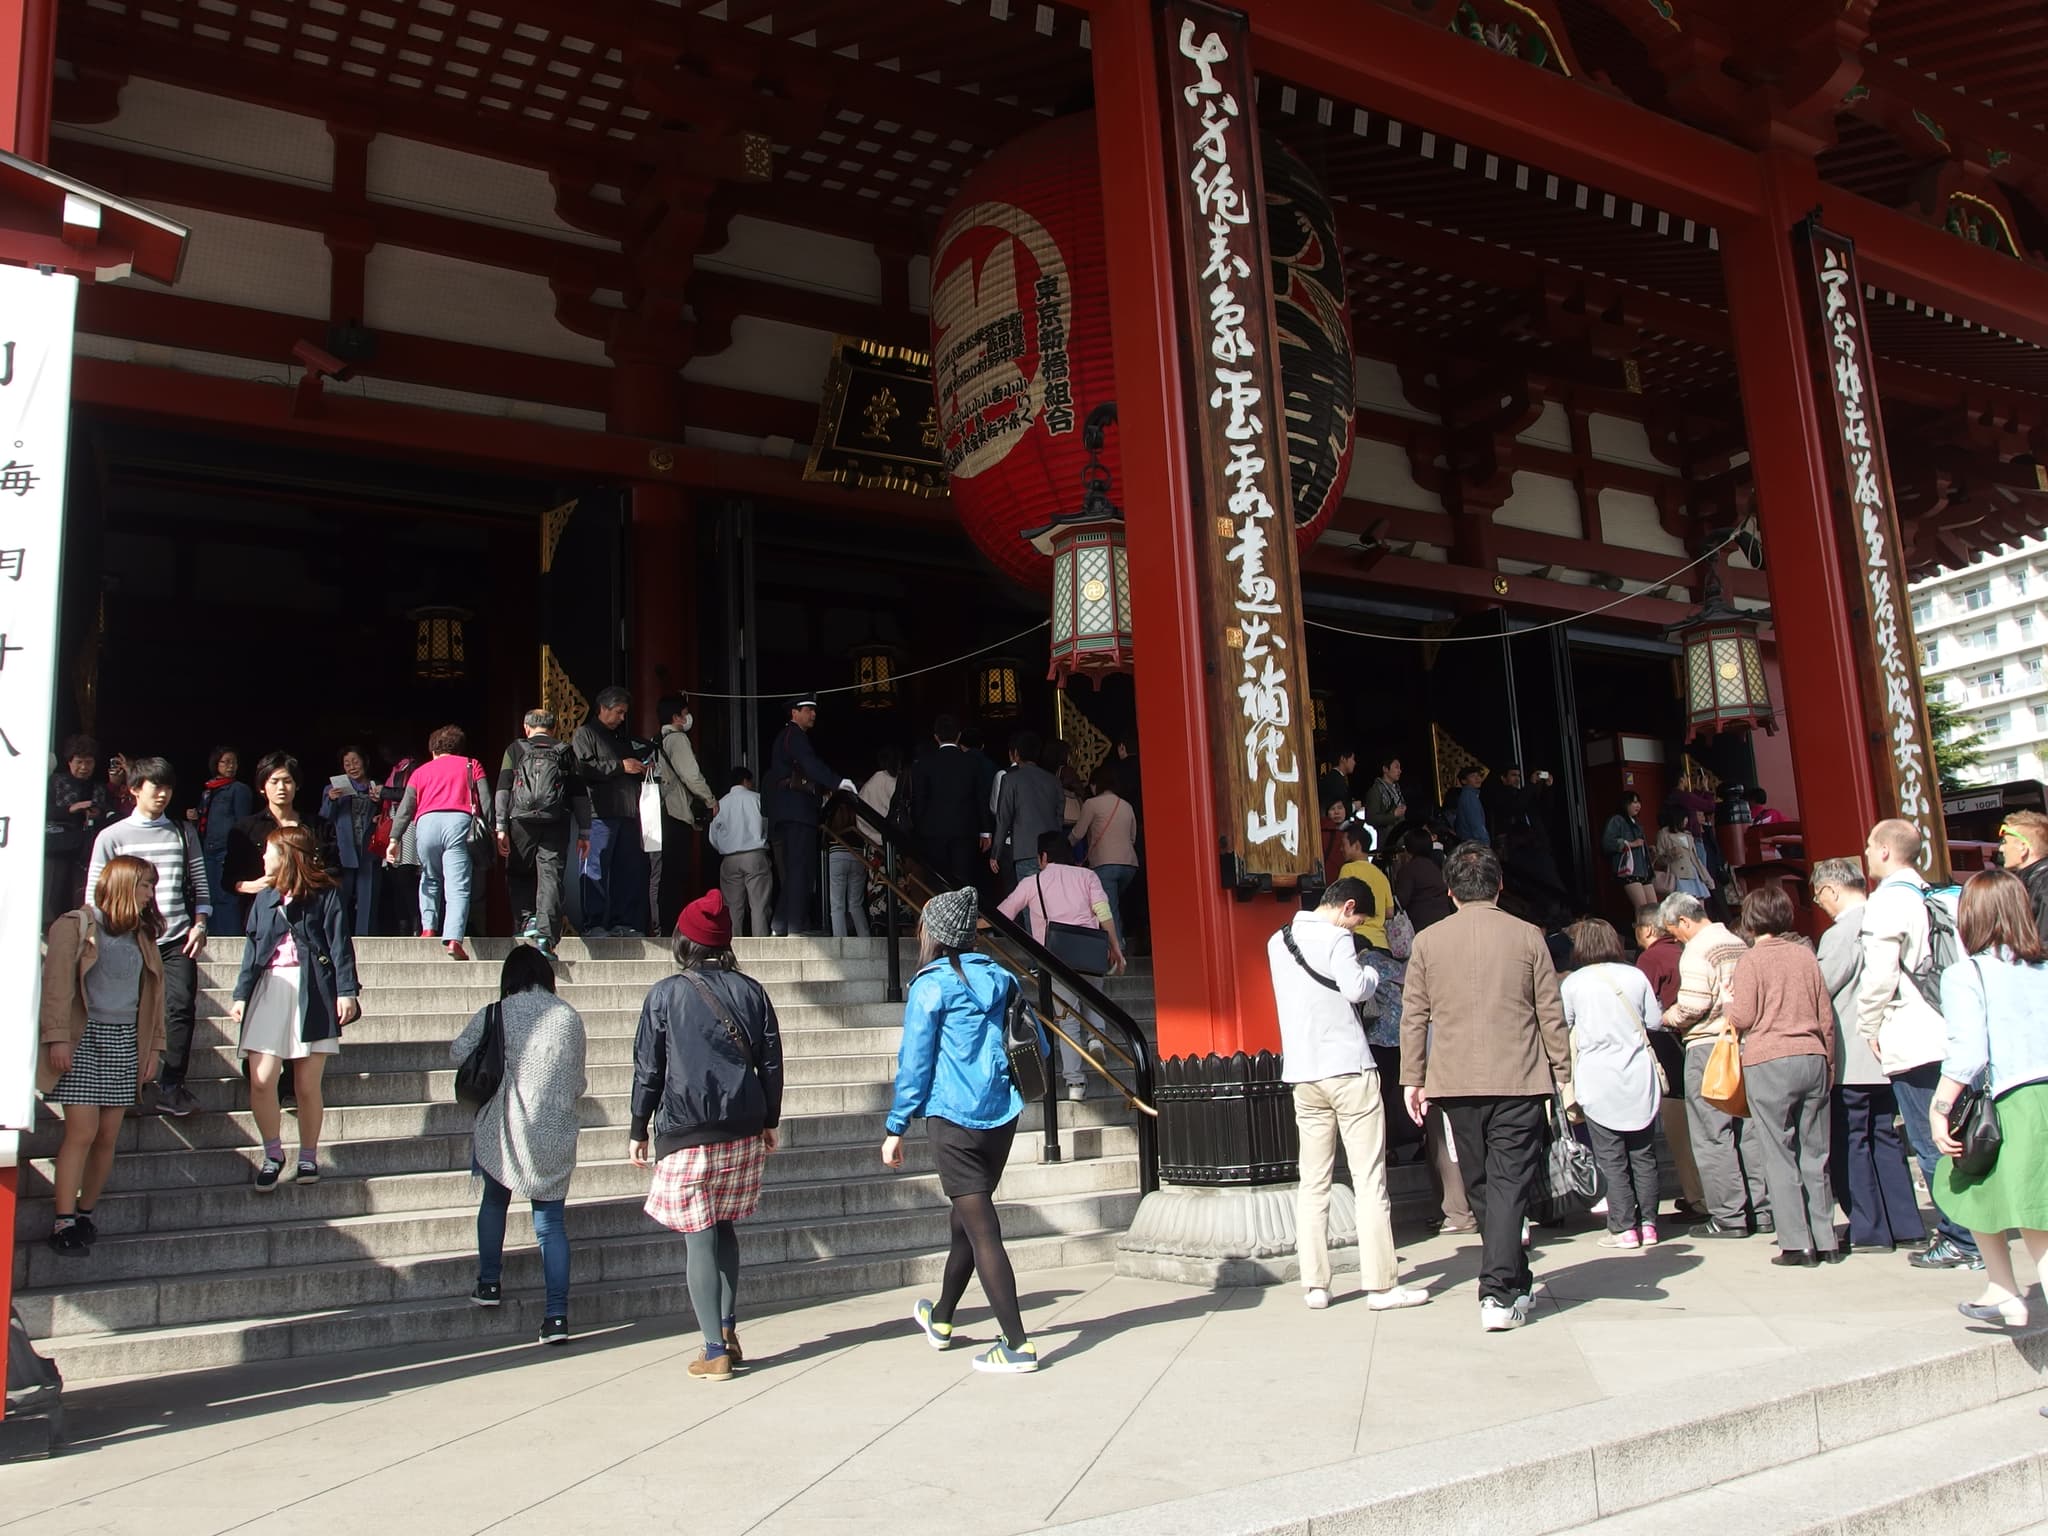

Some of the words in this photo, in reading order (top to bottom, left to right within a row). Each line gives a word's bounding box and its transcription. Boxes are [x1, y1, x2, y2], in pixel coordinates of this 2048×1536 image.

[1035, 275, 1073, 435] 東京新橋組合
[1975, 799, 1997, 810] 100円
